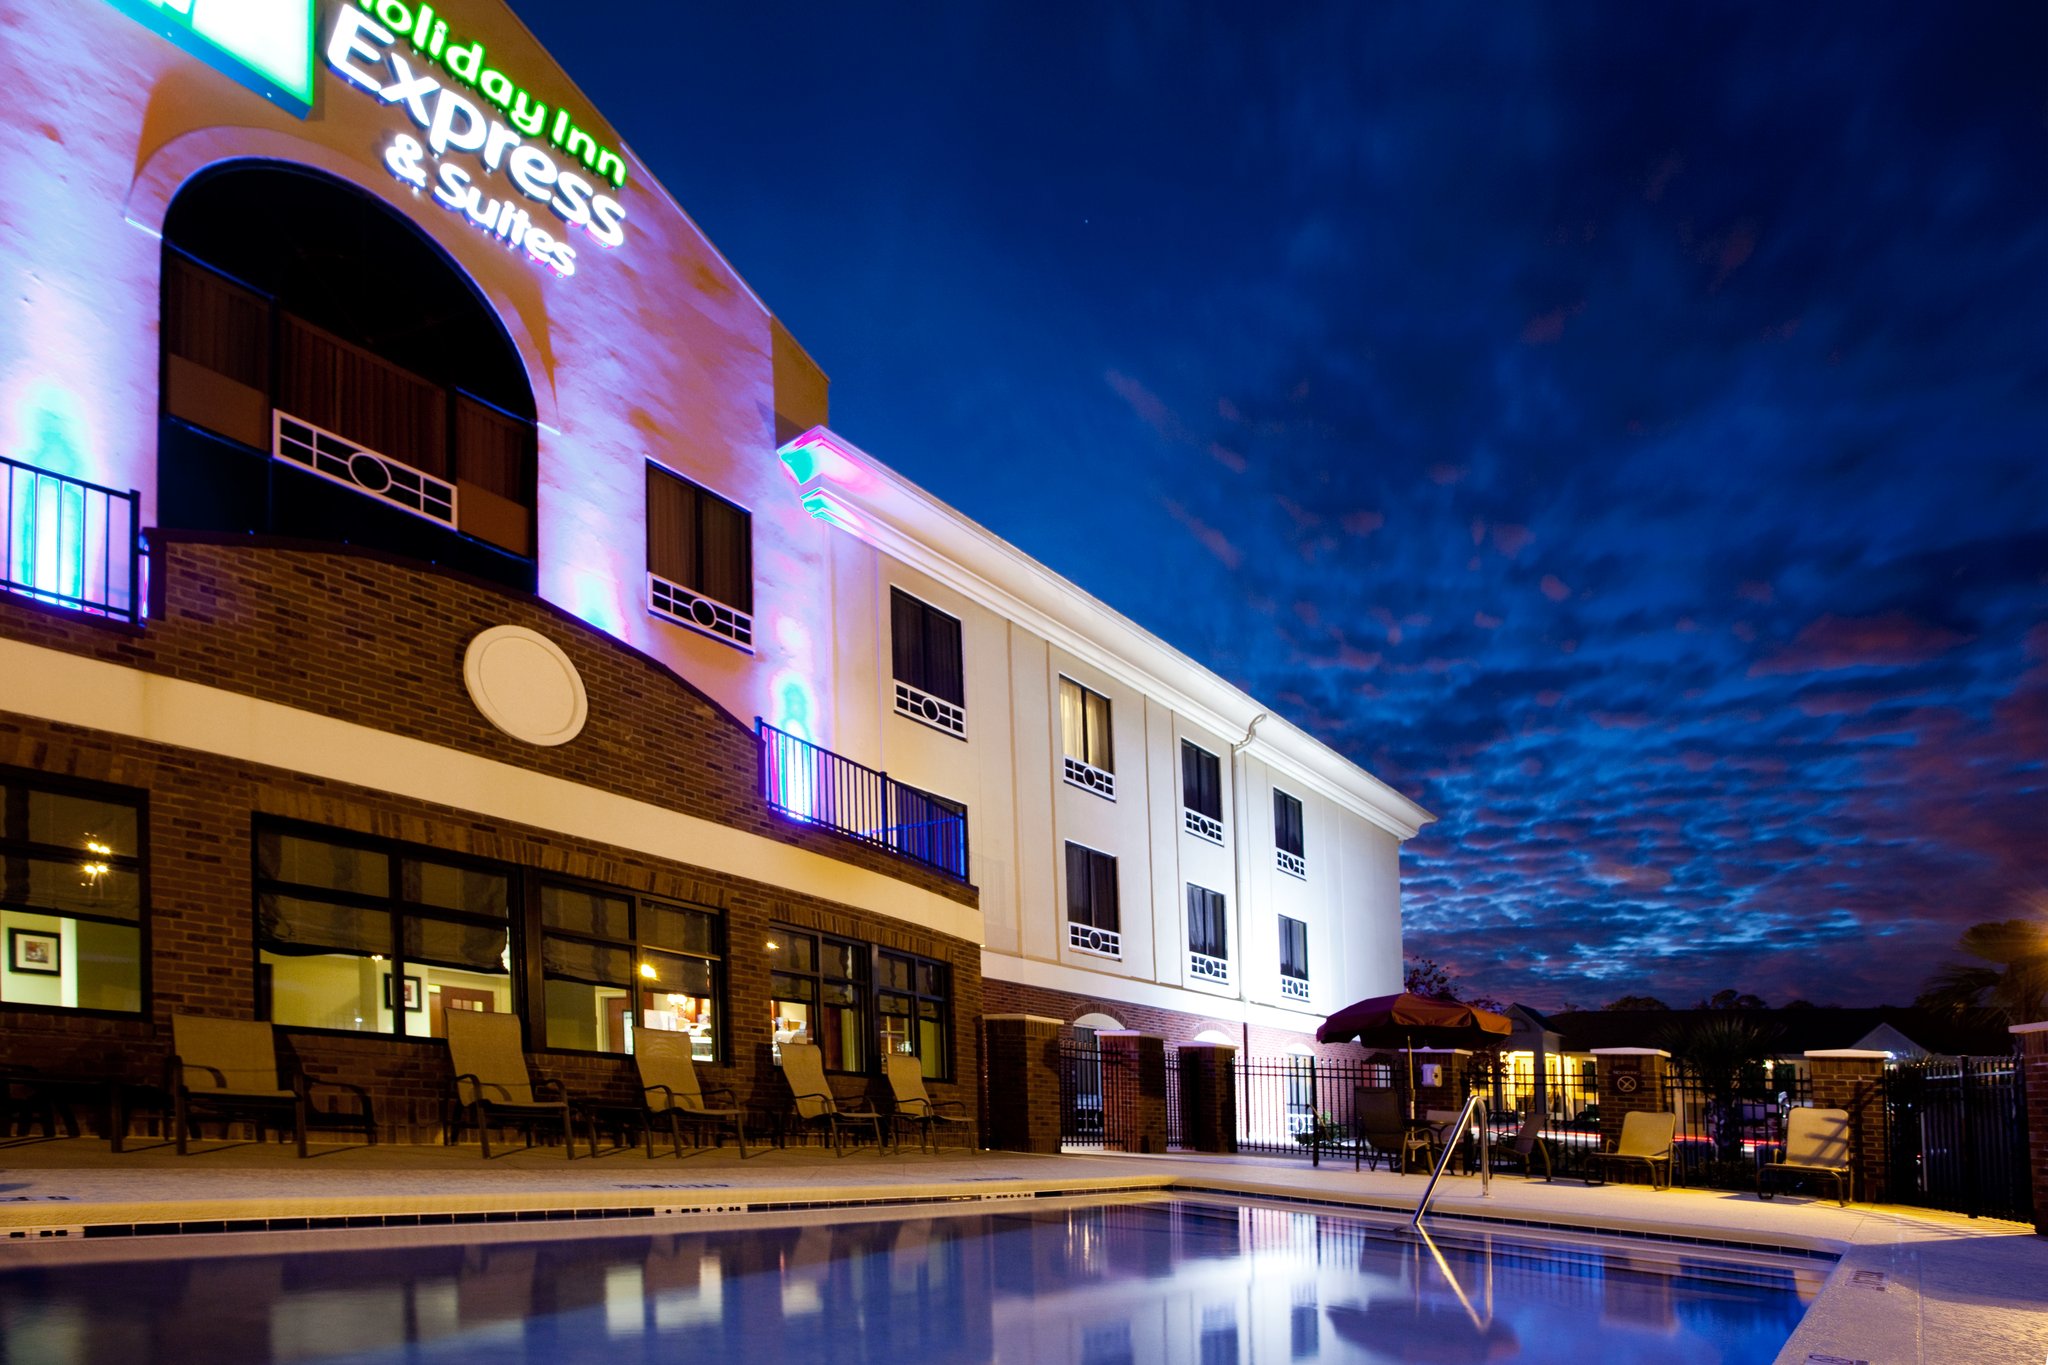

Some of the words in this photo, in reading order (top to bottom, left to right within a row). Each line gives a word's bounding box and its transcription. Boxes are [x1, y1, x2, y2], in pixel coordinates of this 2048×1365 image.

[327, 3, 626, 248] Express
[357, 0, 548, 137] oliday
[551, 107, 628, 189] Inn
[384, 133, 427, 190] &
[434, 162, 577, 276] Suites
